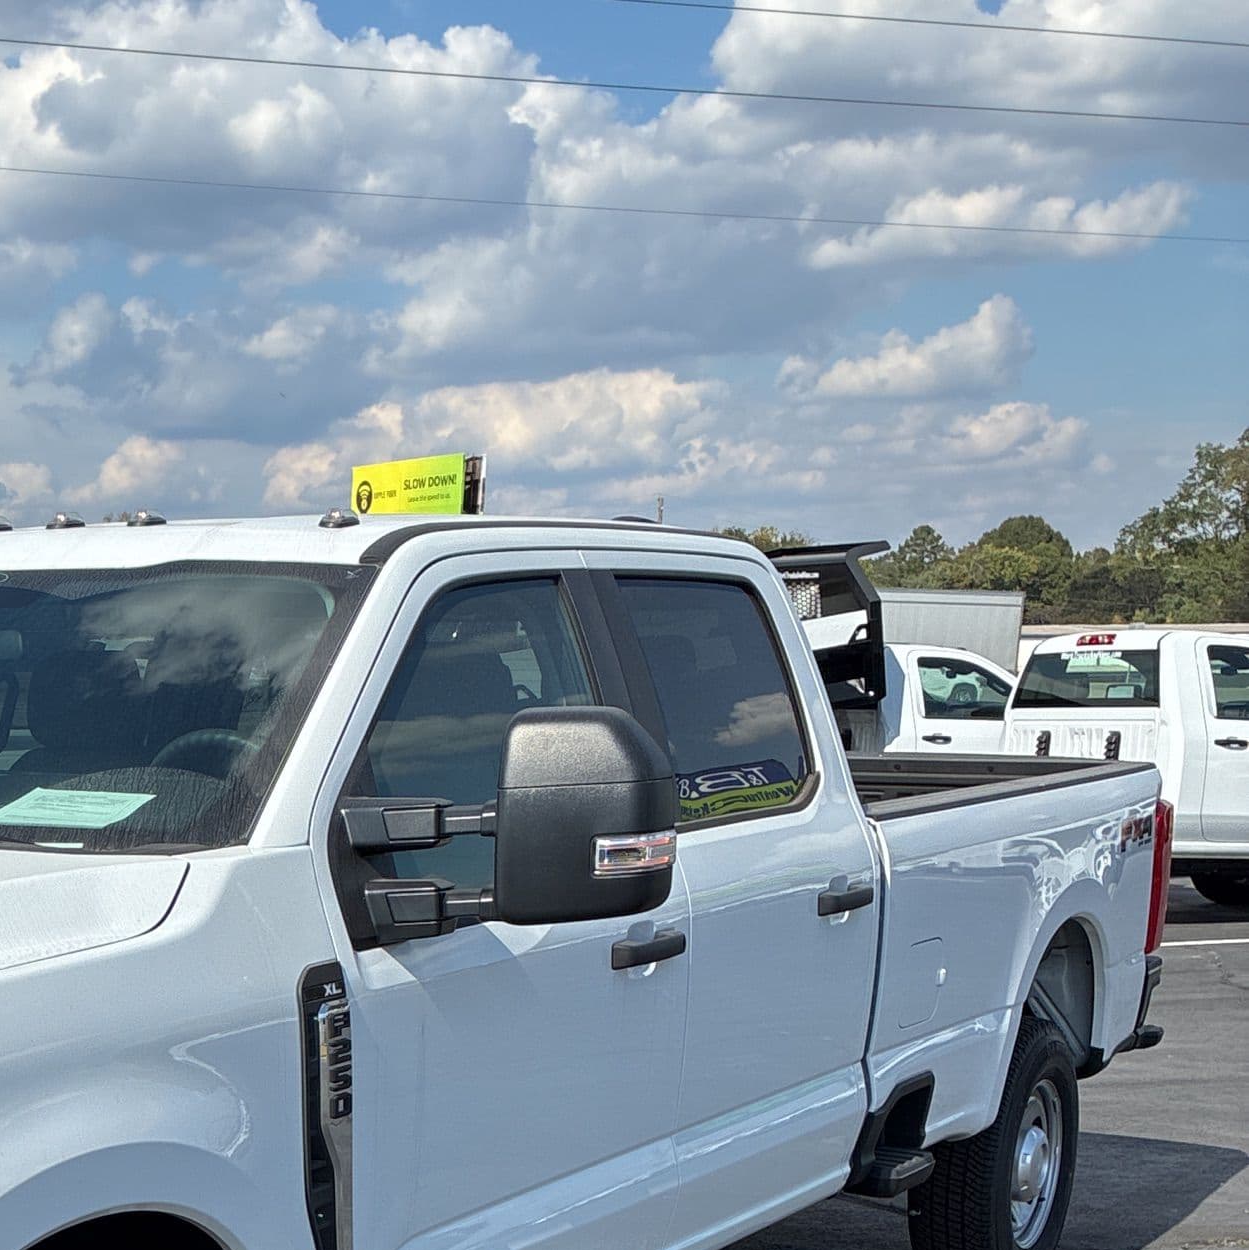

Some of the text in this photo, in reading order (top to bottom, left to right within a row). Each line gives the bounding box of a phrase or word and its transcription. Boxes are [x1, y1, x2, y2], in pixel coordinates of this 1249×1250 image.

[403, 474, 457, 490] SLOW DOWN!
[323, 983, 342, 998] XL
